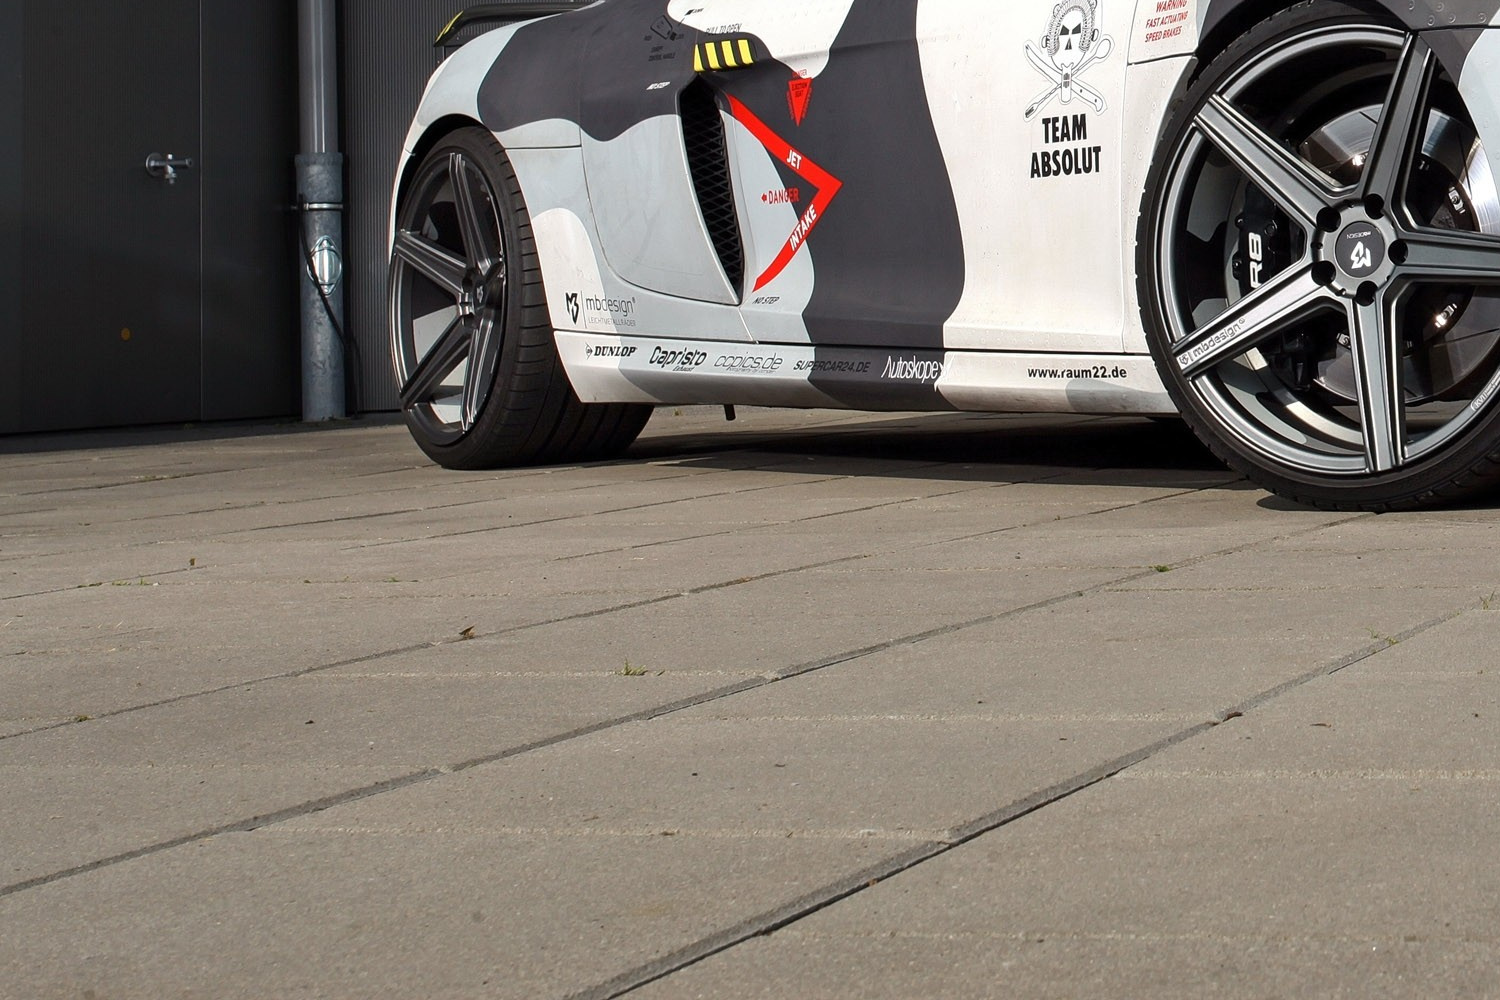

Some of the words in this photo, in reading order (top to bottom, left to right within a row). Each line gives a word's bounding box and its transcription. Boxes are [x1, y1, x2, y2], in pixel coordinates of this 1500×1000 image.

[1146, 16, 1161, 28] FAST
[1145, 31, 1162, 43] SPEED
[1162, 25, 1182, 39] BRAKES
[1042, 113, 1087, 144] TEAM
[786, 149, 802, 170] JET
[1030, 145, 1101, 179] ABSOLUT
[768, 187, 799, 204] DANGER
[789, 204, 817, 251] INTAKE
[1248, 232, 1263, 289] R8
[593, 345, 638, 357] DUNLOP
[649, 345, 708, 368] Capristo
[793, 359, 871, 373] SUPERCAR24.DE
[1027, 365, 1128, 379] www.raum22.de
